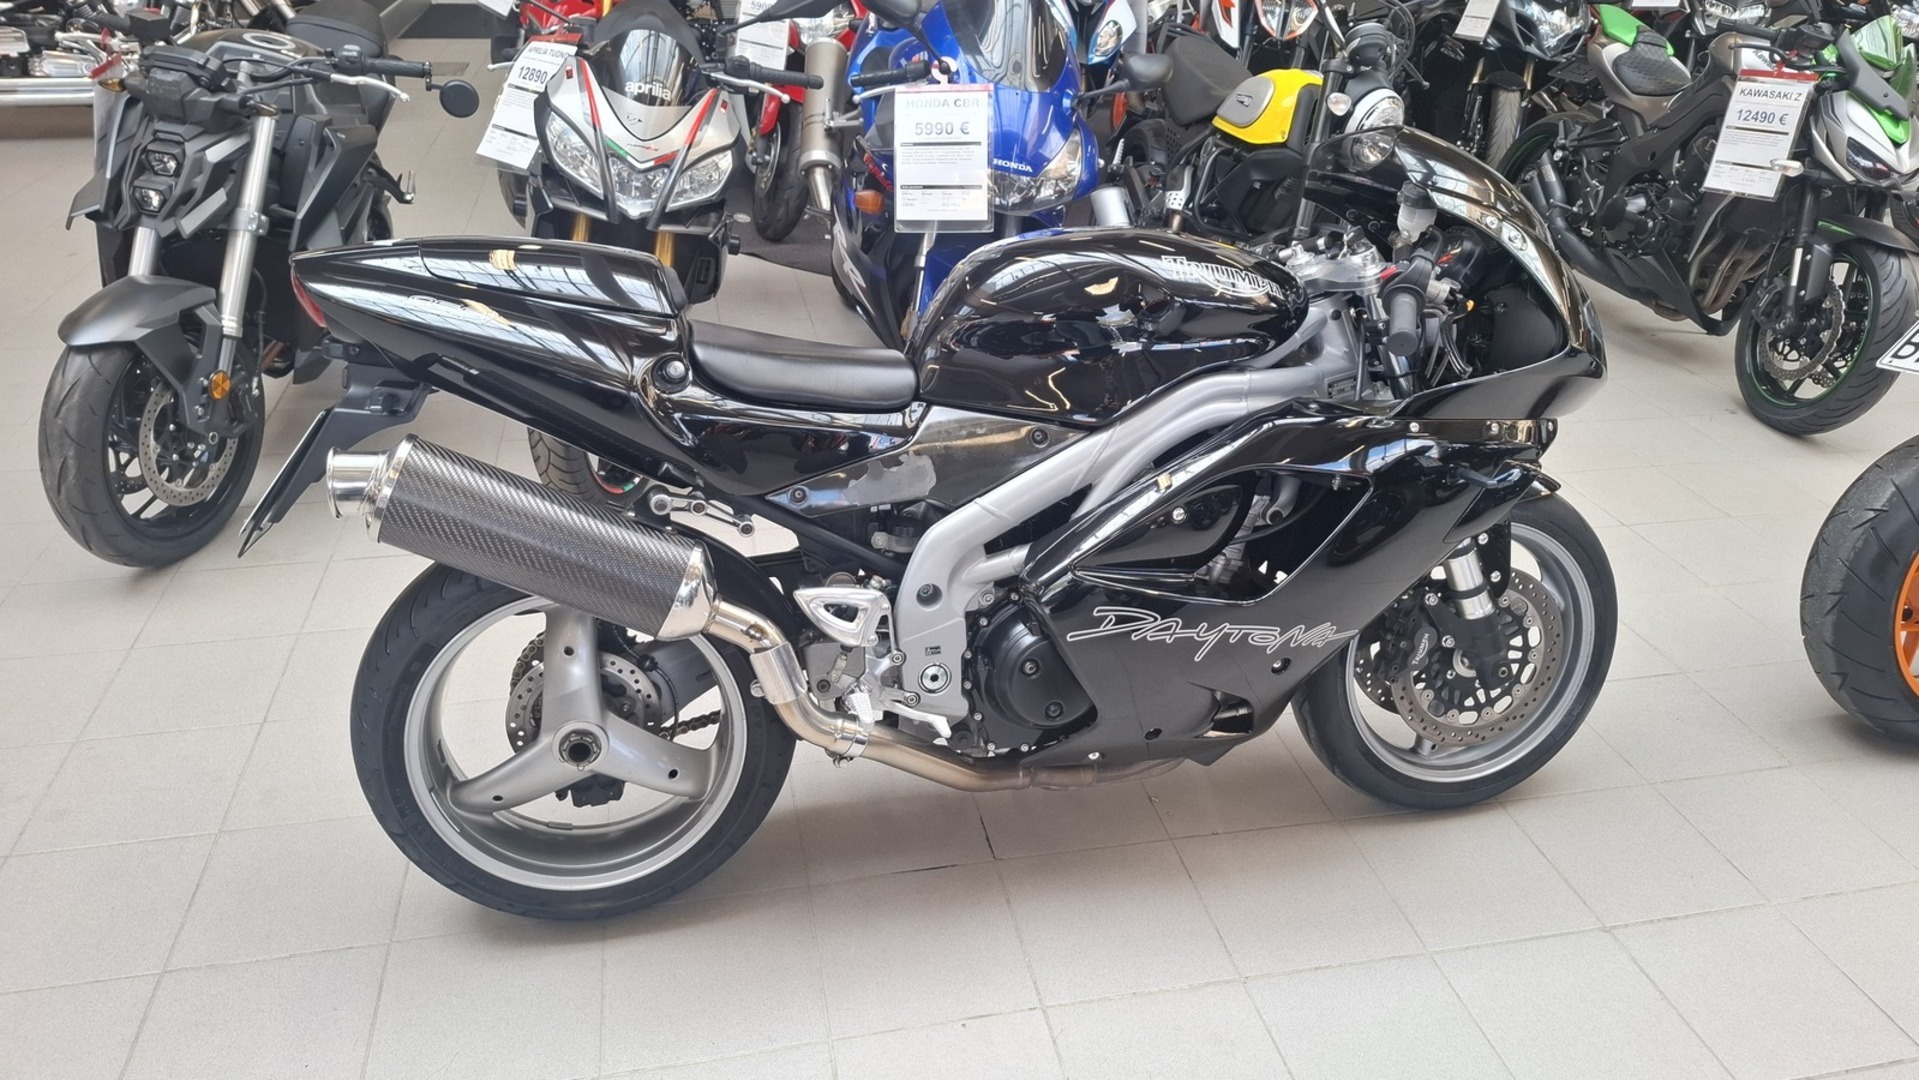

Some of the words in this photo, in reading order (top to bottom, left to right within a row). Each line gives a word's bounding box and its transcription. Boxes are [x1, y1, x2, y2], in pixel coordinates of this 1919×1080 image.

[518, 65, 548, 85] 12890
[625, 80, 672, 101] aprilia
[1739, 87, 1793, 101] KAWASAKI
[1794, 93, 1803, 102] Z
[906, 98, 950, 109] HONDA
[954, 98, 980, 108] CBR
[1736, 108, 1776, 125] 12490
[1779, 113, 1789, 126] €
[915, 121, 954, 136] 5990
[960, 121, 970, 135] €
[993, 158, 1033, 173] HONDA
[1161, 255, 1285, 300] TRIUMPH
[1067, 606, 1359, 662] DAYTONA
[1411, 633, 1430, 666] TRIUMPH
